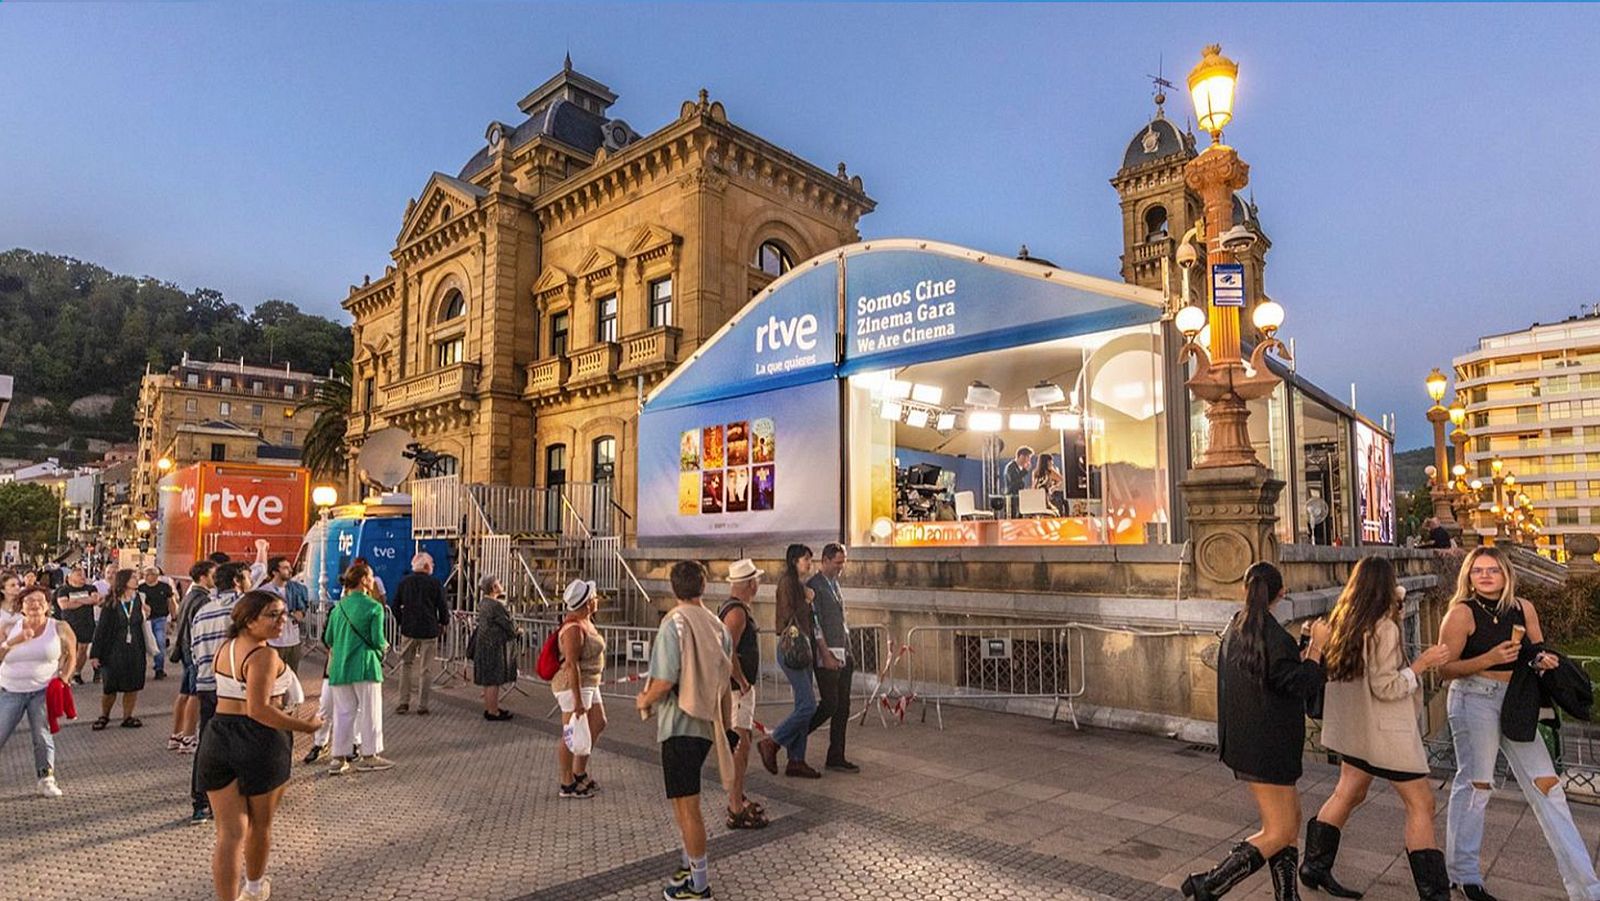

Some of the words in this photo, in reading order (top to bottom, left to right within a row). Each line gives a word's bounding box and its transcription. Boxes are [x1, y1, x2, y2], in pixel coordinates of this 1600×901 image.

[857, 290, 911, 316] Somos
[915, 277, 957, 302] Cine
[755, 313, 818, 353] rtve
[857, 311, 913, 336] Zinema
[916, 301, 956, 323] Gara
[857, 337, 875, 353] We
[877, 334, 900, 349] Are
[902, 323, 955, 344] Cinema
[755, 362, 766, 375] La
[767, 361, 784, 375] que
[784, 354, 817, 371] quieres
[203, 487, 284, 526] rtve
[338, 530, 354, 556] tve
[373, 545, 396, 559] tve
